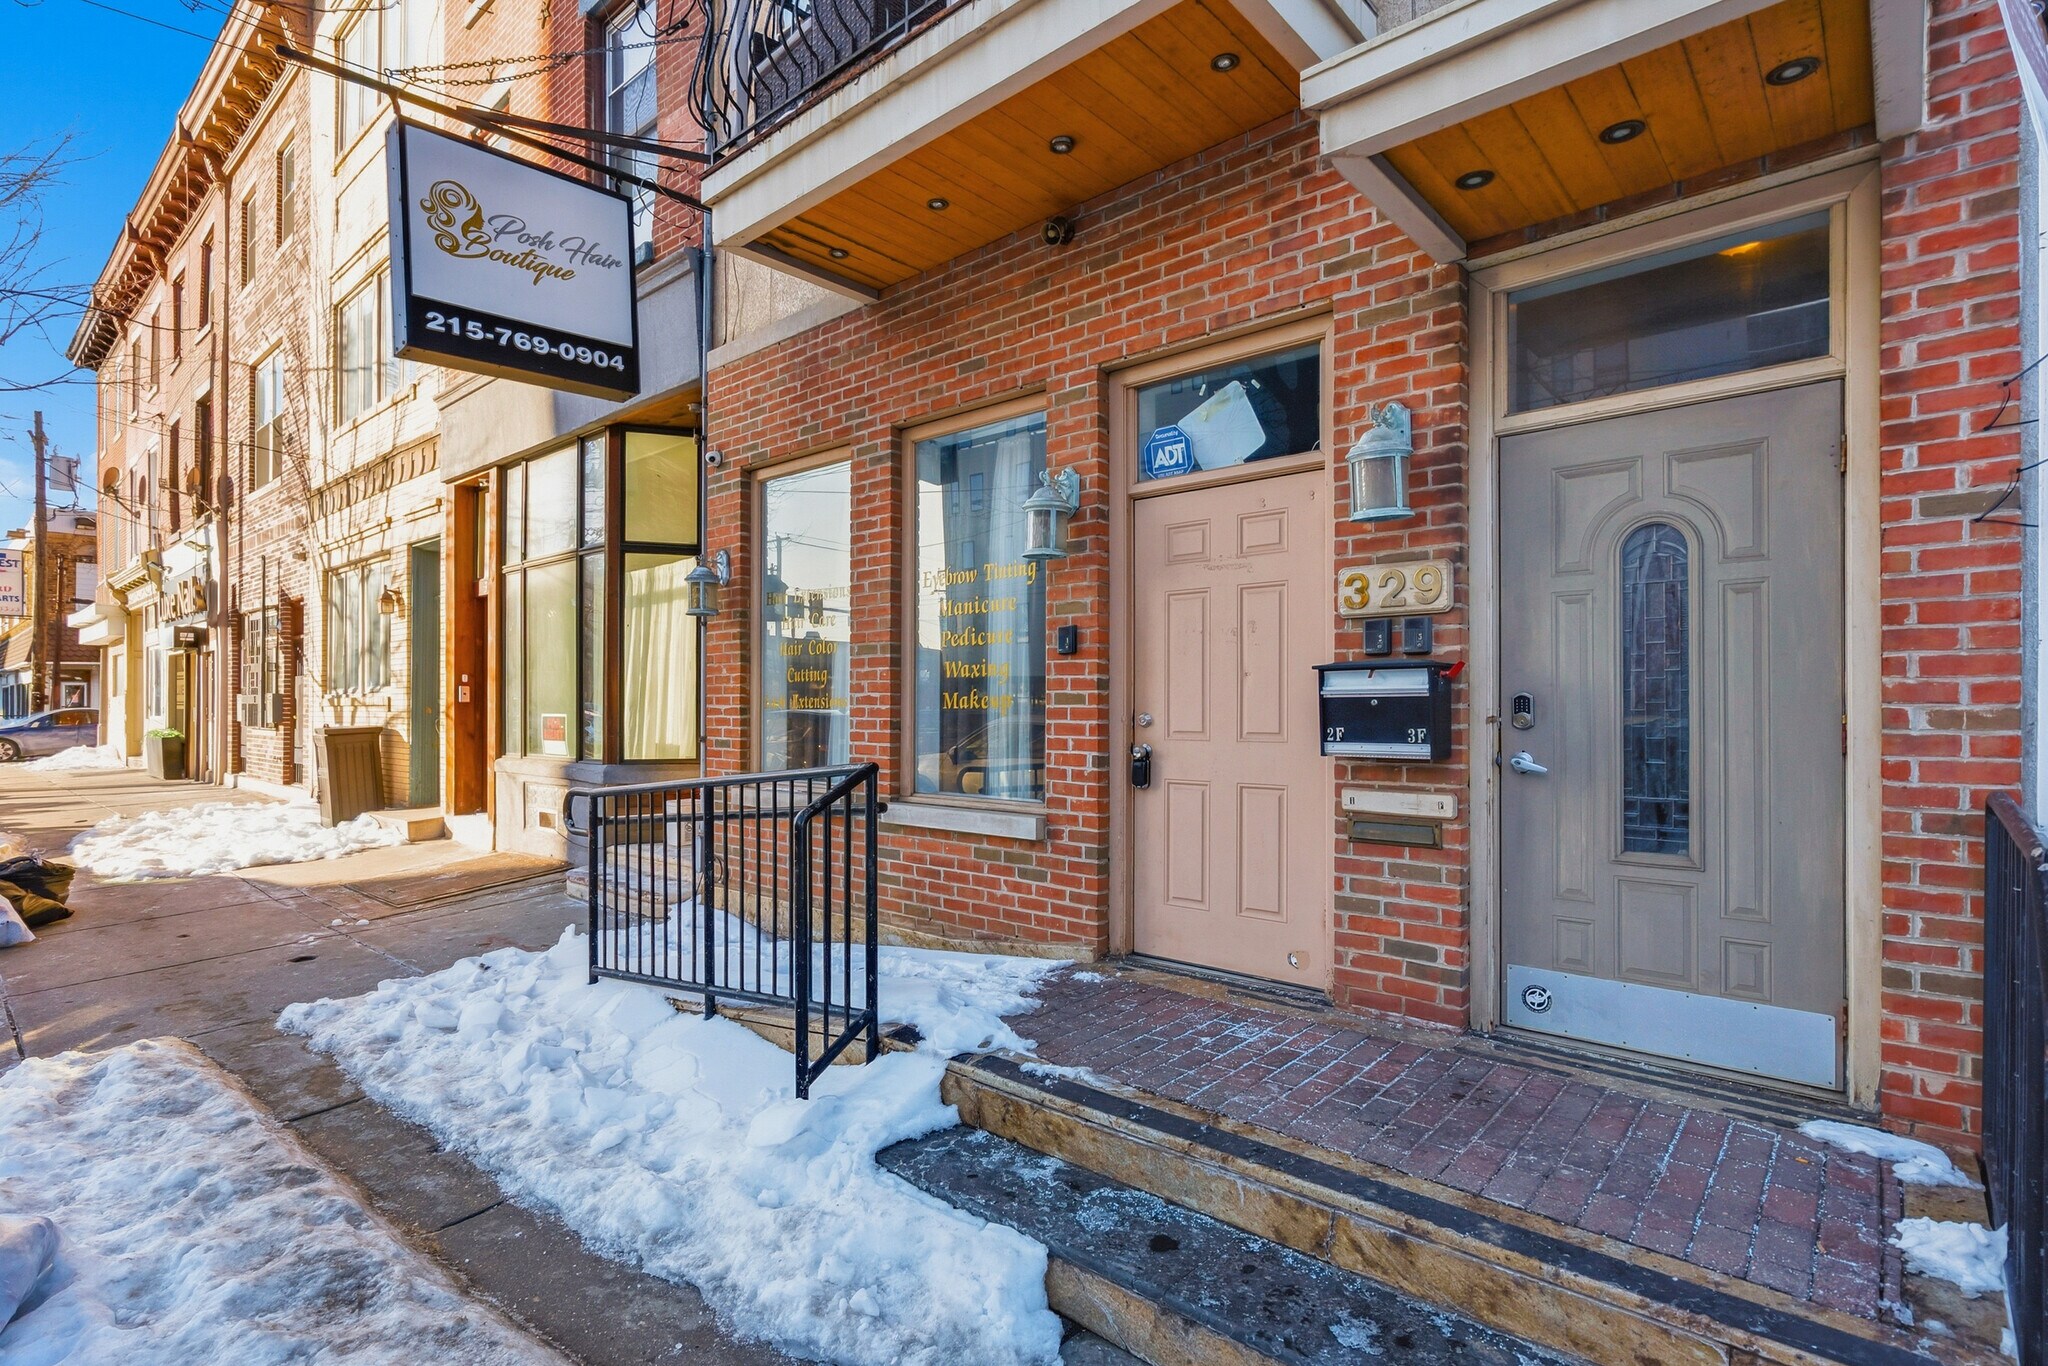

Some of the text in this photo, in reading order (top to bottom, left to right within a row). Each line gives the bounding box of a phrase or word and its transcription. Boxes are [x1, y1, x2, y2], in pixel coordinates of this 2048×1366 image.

[487, 214, 623, 270] Posh Hair
[451, 230, 577, 286] Boutique
[425, 311, 625, 372] 215-769-0904
[1154, 443, 1185, 468] ADT
[922, 560, 1037, 596] Eyebrow Tinting
[1344, 565, 1442, 609] 329
[0, 594, 20, 603] RTS
[938, 595, 1017, 617] Manicure
[811, 612, 837, 628] Care
[808, 637, 838, 656] Color
[941, 626, 1013, 648] Pedicure
[787, 666, 828, 689] Cutting
[943, 658, 1009, 686] Waxing
[942, 688, 1013, 717] Makeup
[1326, 727, 1345, 742] 2F
[1407, 728, 1427, 744] 3F
